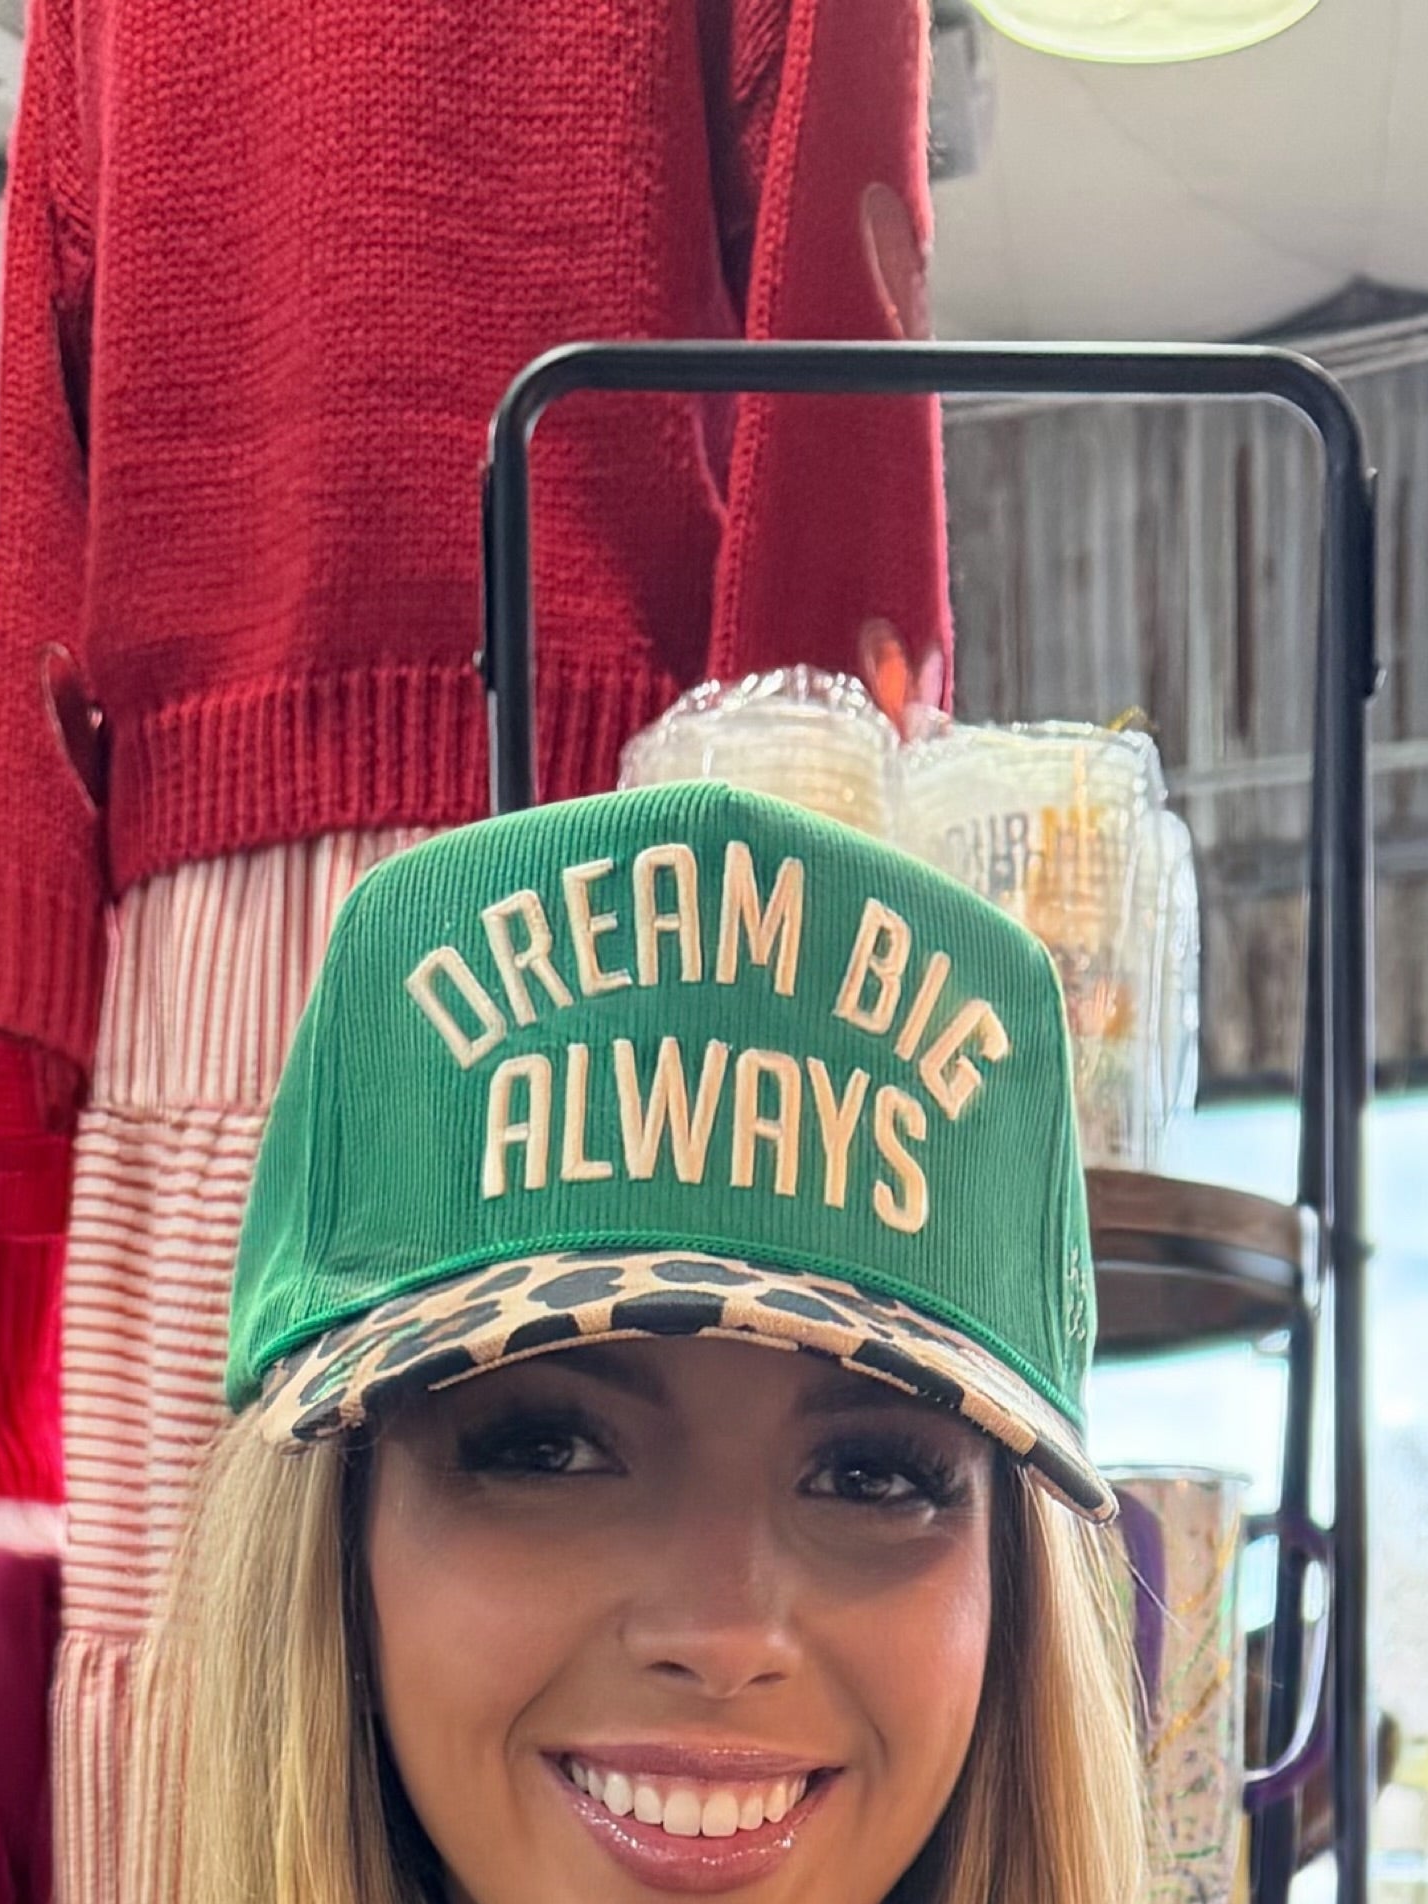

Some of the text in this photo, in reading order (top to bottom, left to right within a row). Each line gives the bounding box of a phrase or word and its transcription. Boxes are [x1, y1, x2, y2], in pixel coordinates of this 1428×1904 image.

[406, 841, 1010, 1120] DREAM BIG
[482, 1036, 931, 1234] ALWAYS
